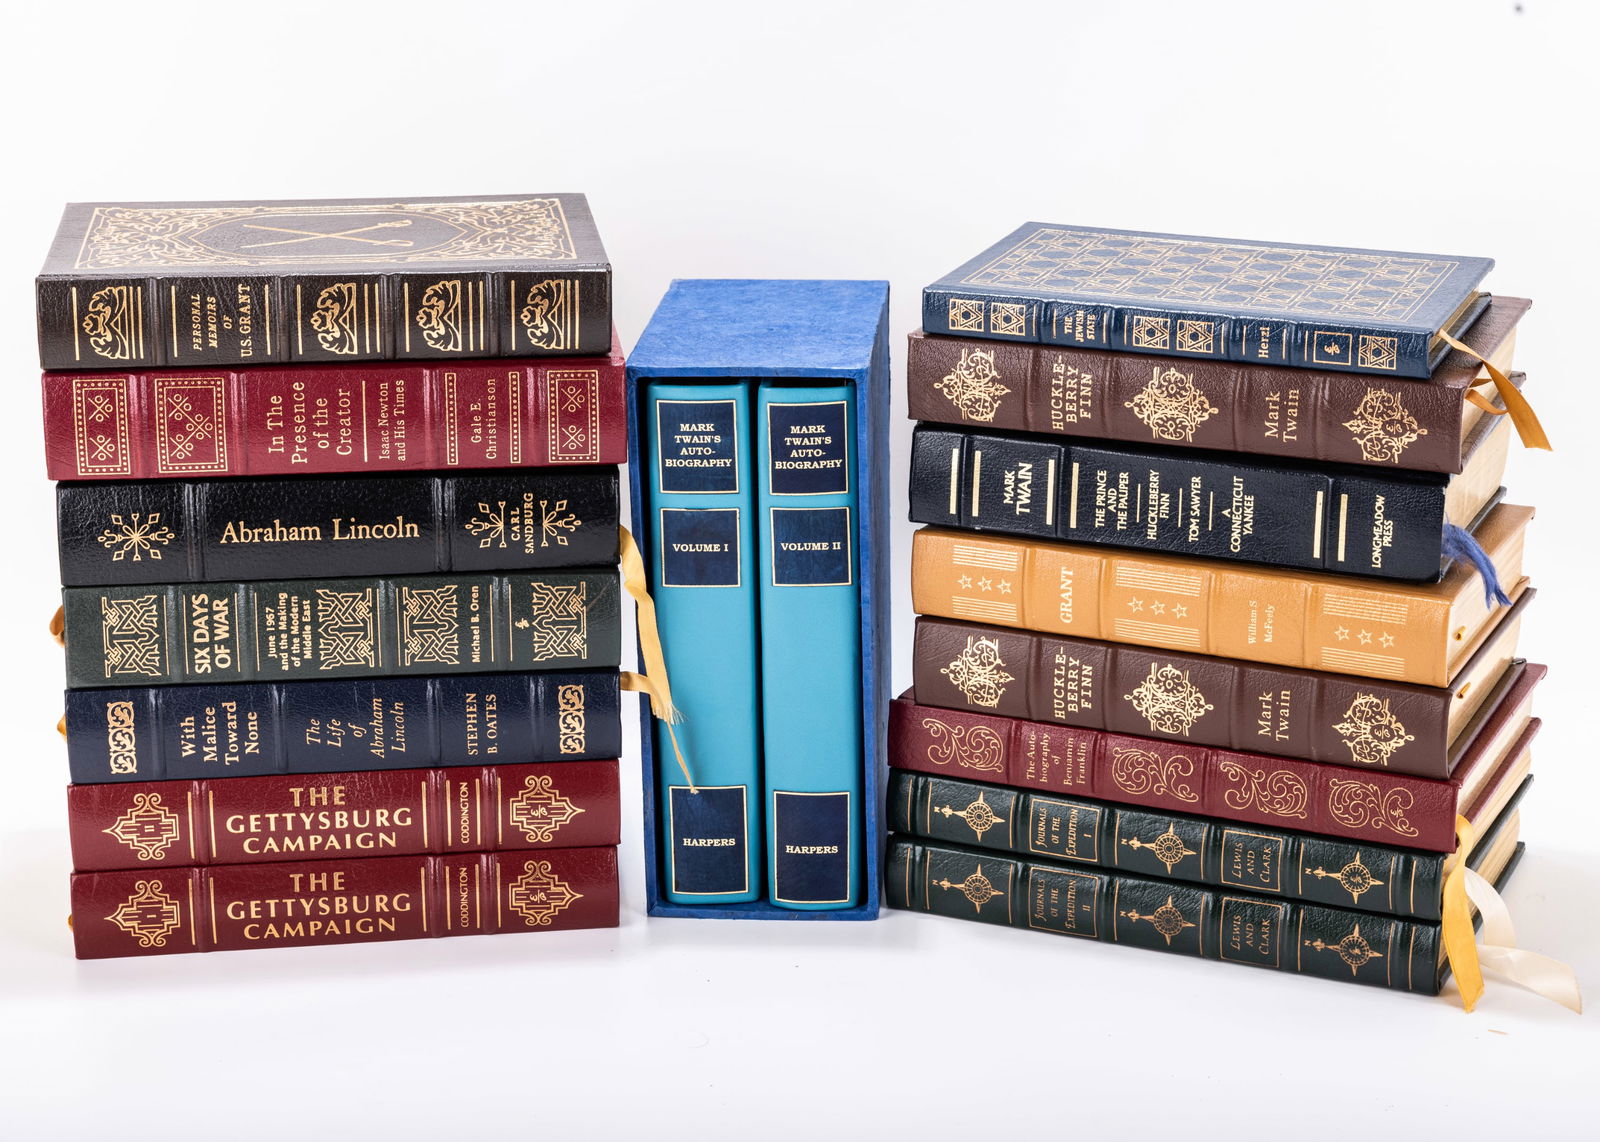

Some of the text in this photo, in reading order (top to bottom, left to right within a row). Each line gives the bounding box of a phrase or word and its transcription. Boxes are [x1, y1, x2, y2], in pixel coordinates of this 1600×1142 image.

[191, 294, 202, 351] PERSONAL
[208, 296, 218, 348] MEMOIRS
[224, 315, 232, 330] OF
[1064, 316, 1072, 335] THE
[1075, 310, 1084, 343] JEWISH
[1086, 314, 1096, 340] STATE
[1258, 326, 1271, 358] Herzl
[1051, 354, 1065, 431] HUCKLE-
[1066, 366, 1078, 423] BERRY
[1080, 373, 1093, 419] FINN
[267, 396, 284, 454] In The
[292, 382, 308, 464] Presence
[313, 398, 330, 449] of the
[336, 388, 352, 455] Creator
[378, 382, 390, 460] Isaac Newton
[394, 379, 406, 461] and His Times
[471, 398, 482, 443] Gale E.
[486, 378, 497, 459] Christianson
[680, 423, 715, 432] MARK
[790, 425, 826, 434] MARK
[1264, 391, 1280, 439] Mark
[1282, 389, 1300, 443] Twain
[675, 435, 721, 444] TWAIN'S
[680, 447, 716, 456] AUTO-
[784, 436, 832, 446] TWAIN'S
[790, 449, 826, 458] AUTO-
[665, 458, 732, 468] BIOGRAPHY
[775, 459, 843, 470] BIOGRAPHY
[1003, 470, 1015, 504] MARK
[1016, 462, 1033, 515] TWAIN
[1095, 470, 1107, 528] THE PRINCE
[1107, 488, 1118, 513] AND
[1117, 472, 1129, 530] THE PAUPER
[1147, 469, 1160, 540] HUCKLEBERRY
[1160, 493, 1170, 519] FINN
[220, 516, 420, 544] Abraham Lincoln
[510, 507, 520, 541] CARL
[524, 493, 534, 554] SANDBURG
[1189, 476, 1201, 542] TOM SAWYER
[1221, 508, 1231, 517] A
[1231, 476, 1244, 552] CONNECTICUT
[1243, 494, 1254, 535] YANKEE
[672, 543, 729, 552] VOLUME I
[781, 542, 841, 551] VOLUME II
[1372, 495, 1386, 568] LONGMEADOW
[1382, 520, 1394, 547] PRESS
[1060, 566, 1074, 624] GRANT
[192, 594, 212, 674] SIX DAYS
[212, 598, 232, 668] OF WAR
[266, 607, 278, 658] June 1967
[278, 592, 289, 671] and the Making
[290, 596, 300, 667] of the Modern
[302, 600, 312, 659] Middle East
[470, 586, 481, 663] Michael B. Oren
[1248, 609, 1257, 644] William
[1264, 604, 1276, 643] McFeely
[1054, 647, 1066, 720] HUCKLE-
[1068, 656, 1079, 713] BERRY
[1081, 664, 1093, 709] FINN
[202, 706, 218, 762] Malice
[222, 701, 240, 765] Toward
[245, 711, 259, 754] None
[306, 718, 321, 745] The
[327, 719, 346, 747] Life
[348, 723, 366, 738] of
[369, 698, 385, 758] Abraham
[390, 701, 406, 753] Lincoln
[466, 693, 478, 755] STEPHEN
[485, 694, 498, 754] B. OATES
[1258, 691, 1272, 737] Mark
[1276, 690, 1290, 742] Twain
[180, 716, 196, 758] With
[1026, 730, 1036, 780] The Auto-
[1040, 733, 1050, 783] biography
[1052, 755, 1061, 765] of
[1063, 738, 1074, 786] Benjamin
[1076, 742, 1087, 784] Franklin
[289, 786, 346, 807] THE
[460, 782, 470, 843] CODDINGTON
[226, 808, 412, 834] GETTYSBURG
[683, 838, 736, 847] HARPERS
[1052, 817, 1060, 829] THE
[243, 832, 397, 854] CAMPAIGN
[785, 845, 838, 854] HARPERS
[1231, 842, 1244, 879] LEWIS
[1246, 850, 1255, 875] AND
[1260, 846, 1272, 883] CLARK
[290, 871, 345, 893] THE
[460, 868, 469, 928] CODDINGTON
[1051, 888, 1059, 901] THE
[226, 893, 411, 920] GETTYSBURG
[244, 917, 396, 940] CAMPAIGN
[1231, 915, 1242, 951] LEWIS
[1245, 923, 1254, 947] AND
[1259, 919, 1271, 955] CLARK
